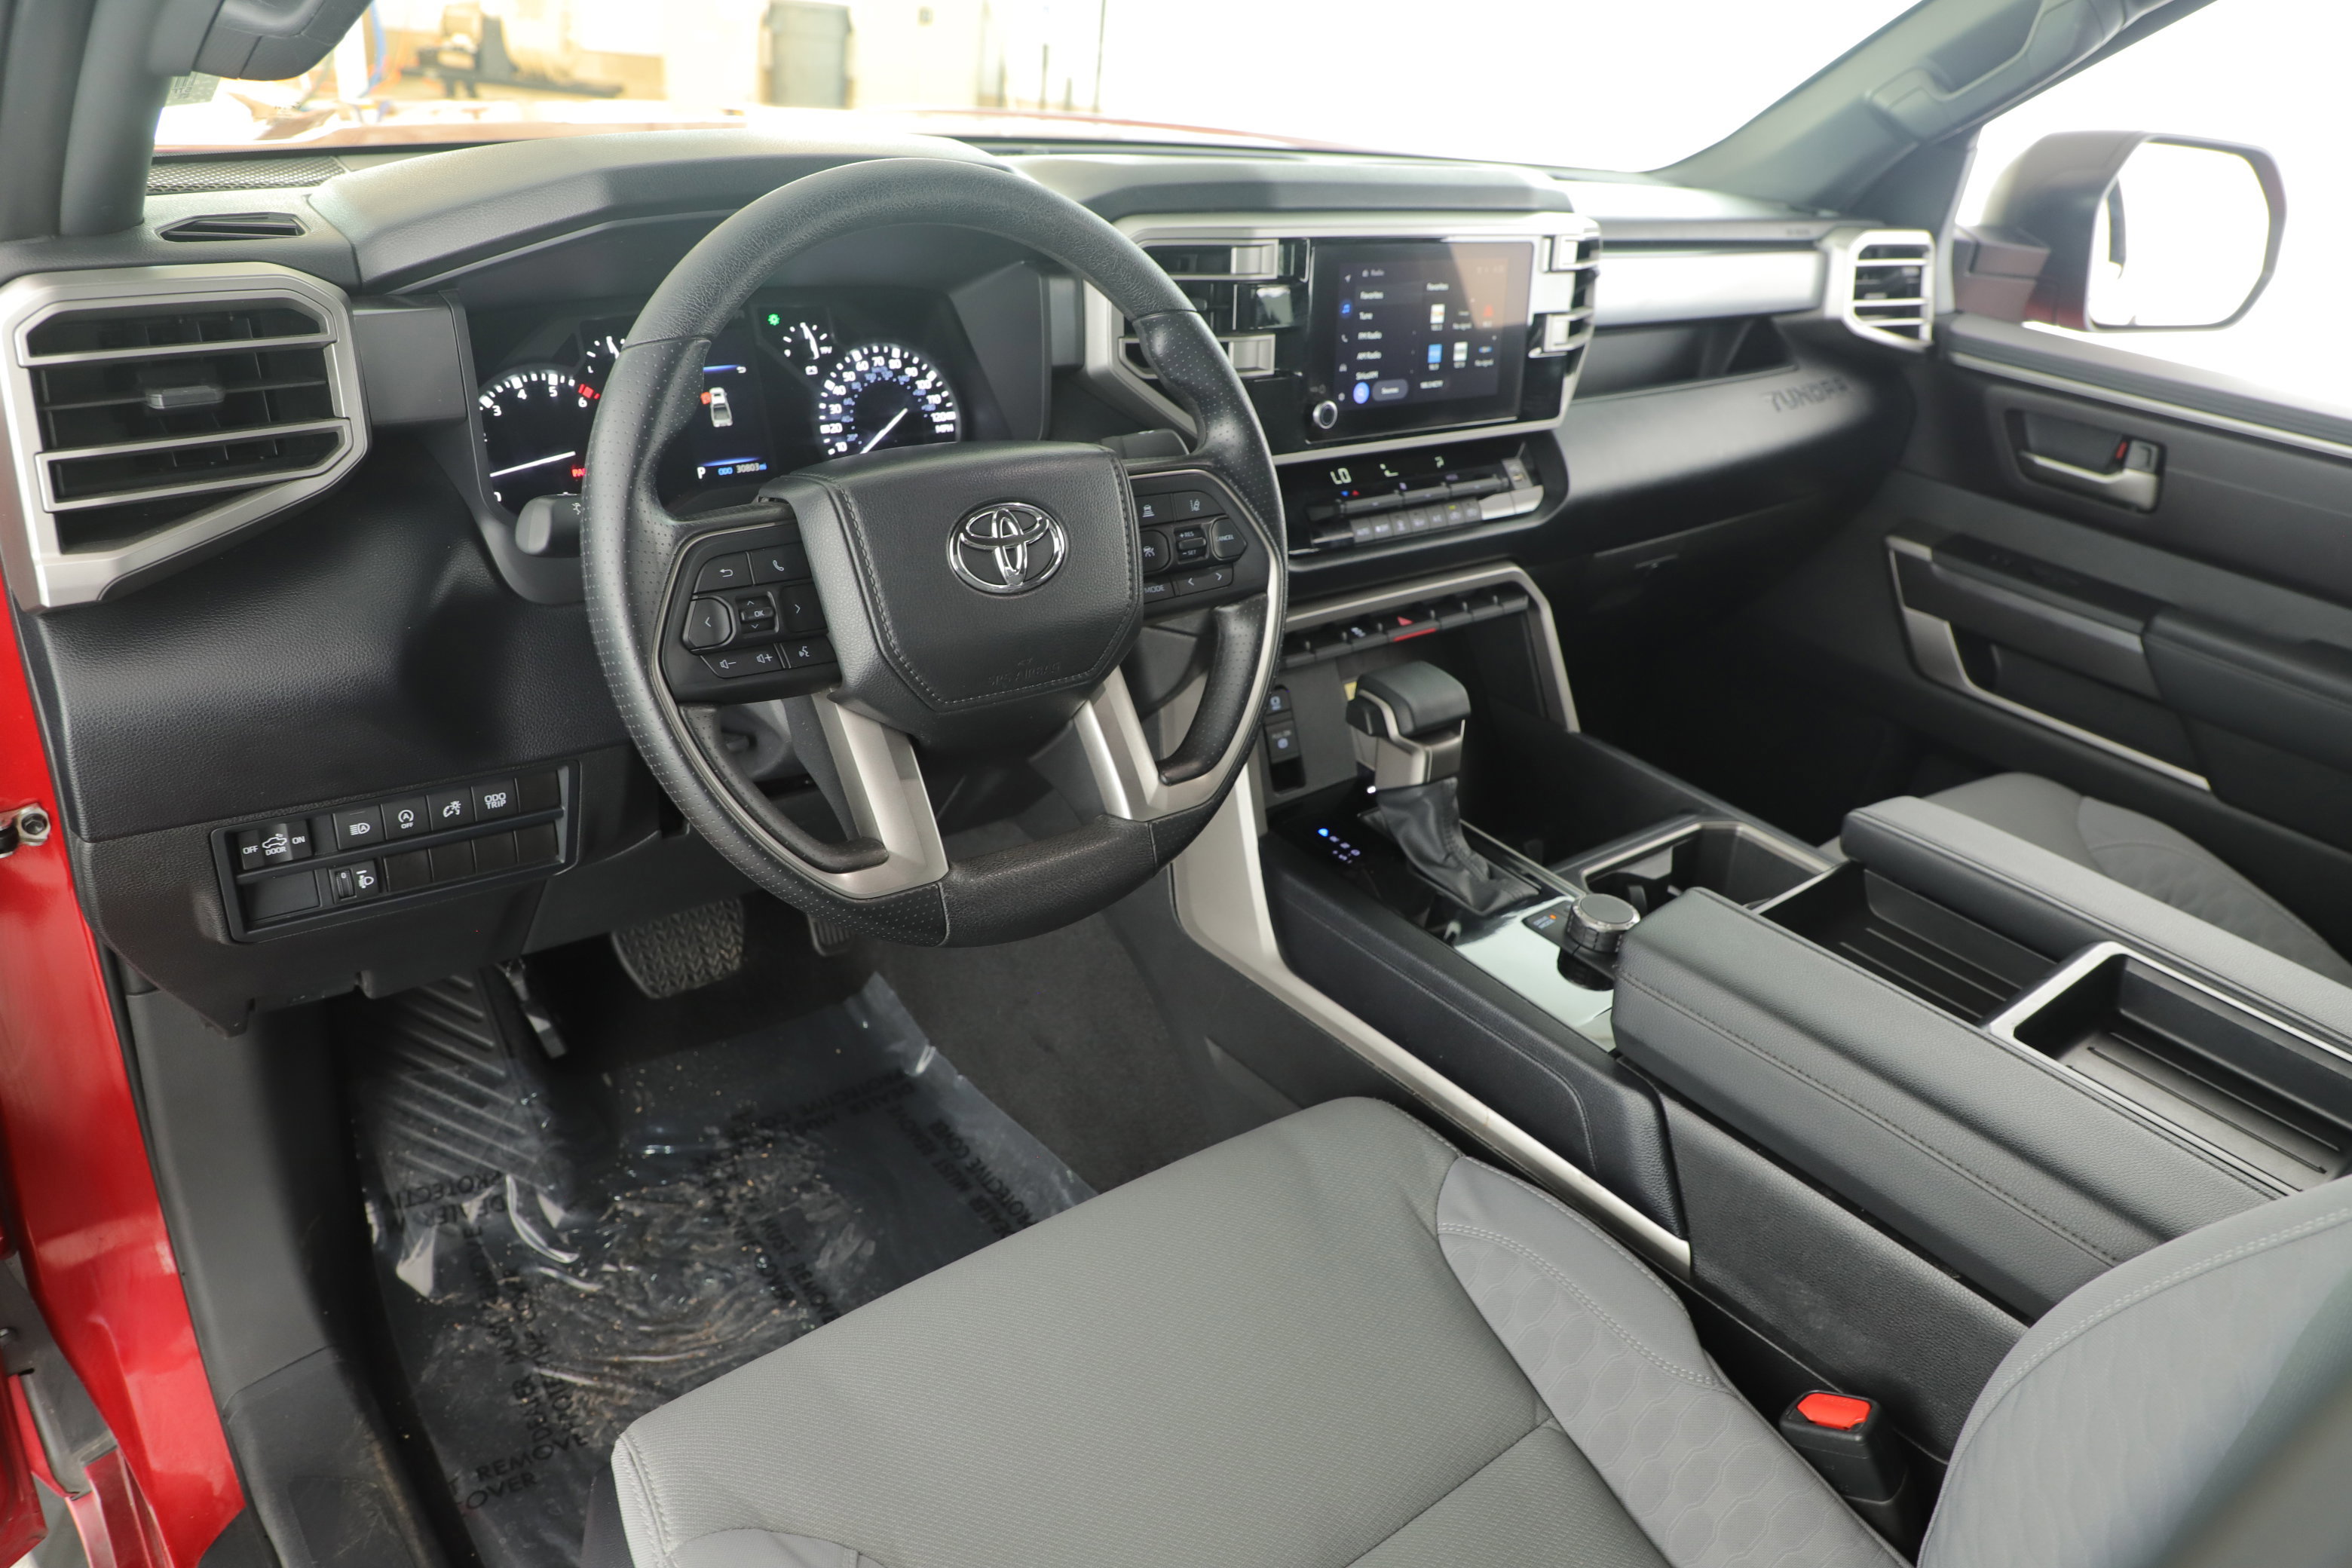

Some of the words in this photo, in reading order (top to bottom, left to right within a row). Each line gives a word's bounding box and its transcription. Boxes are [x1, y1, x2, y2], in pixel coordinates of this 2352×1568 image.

[856, 361, 869, 371] 60
[871, 356, 885, 367] 70
[843, 371, 856, 382] 50
[905, 367, 918, 378] 90
[915, 379, 933, 390] 100
[517, 389, 527, 400] 4
[549, 387, 558, 397] 5
[833, 385, 847, 395] 40
[578, 398, 587, 408] 6
[926, 394, 942, 404] 110
[492, 406, 502, 416] 3
[828, 404, 842, 414] 30
[930, 412, 946, 422] 120
[830, 423, 843, 433] 20
[936, 424, 954, 433] MPH
[835, 442, 847, 452] 10
[697, 467, 706, 479] P
[1330, 467, 1352, 485] LO
[1144, 584, 1165, 593] MODE
[484, 792, 507, 804] ODO
[485, 799, 507, 810] TRIP
[292, 835, 305, 845] ON
[243, 845, 259, 855] OFF
[265, 847, 287, 856] DOOR
[476, 1432, 585, 1481] REMOVE
[457, 1472, 537, 1511] OVER
